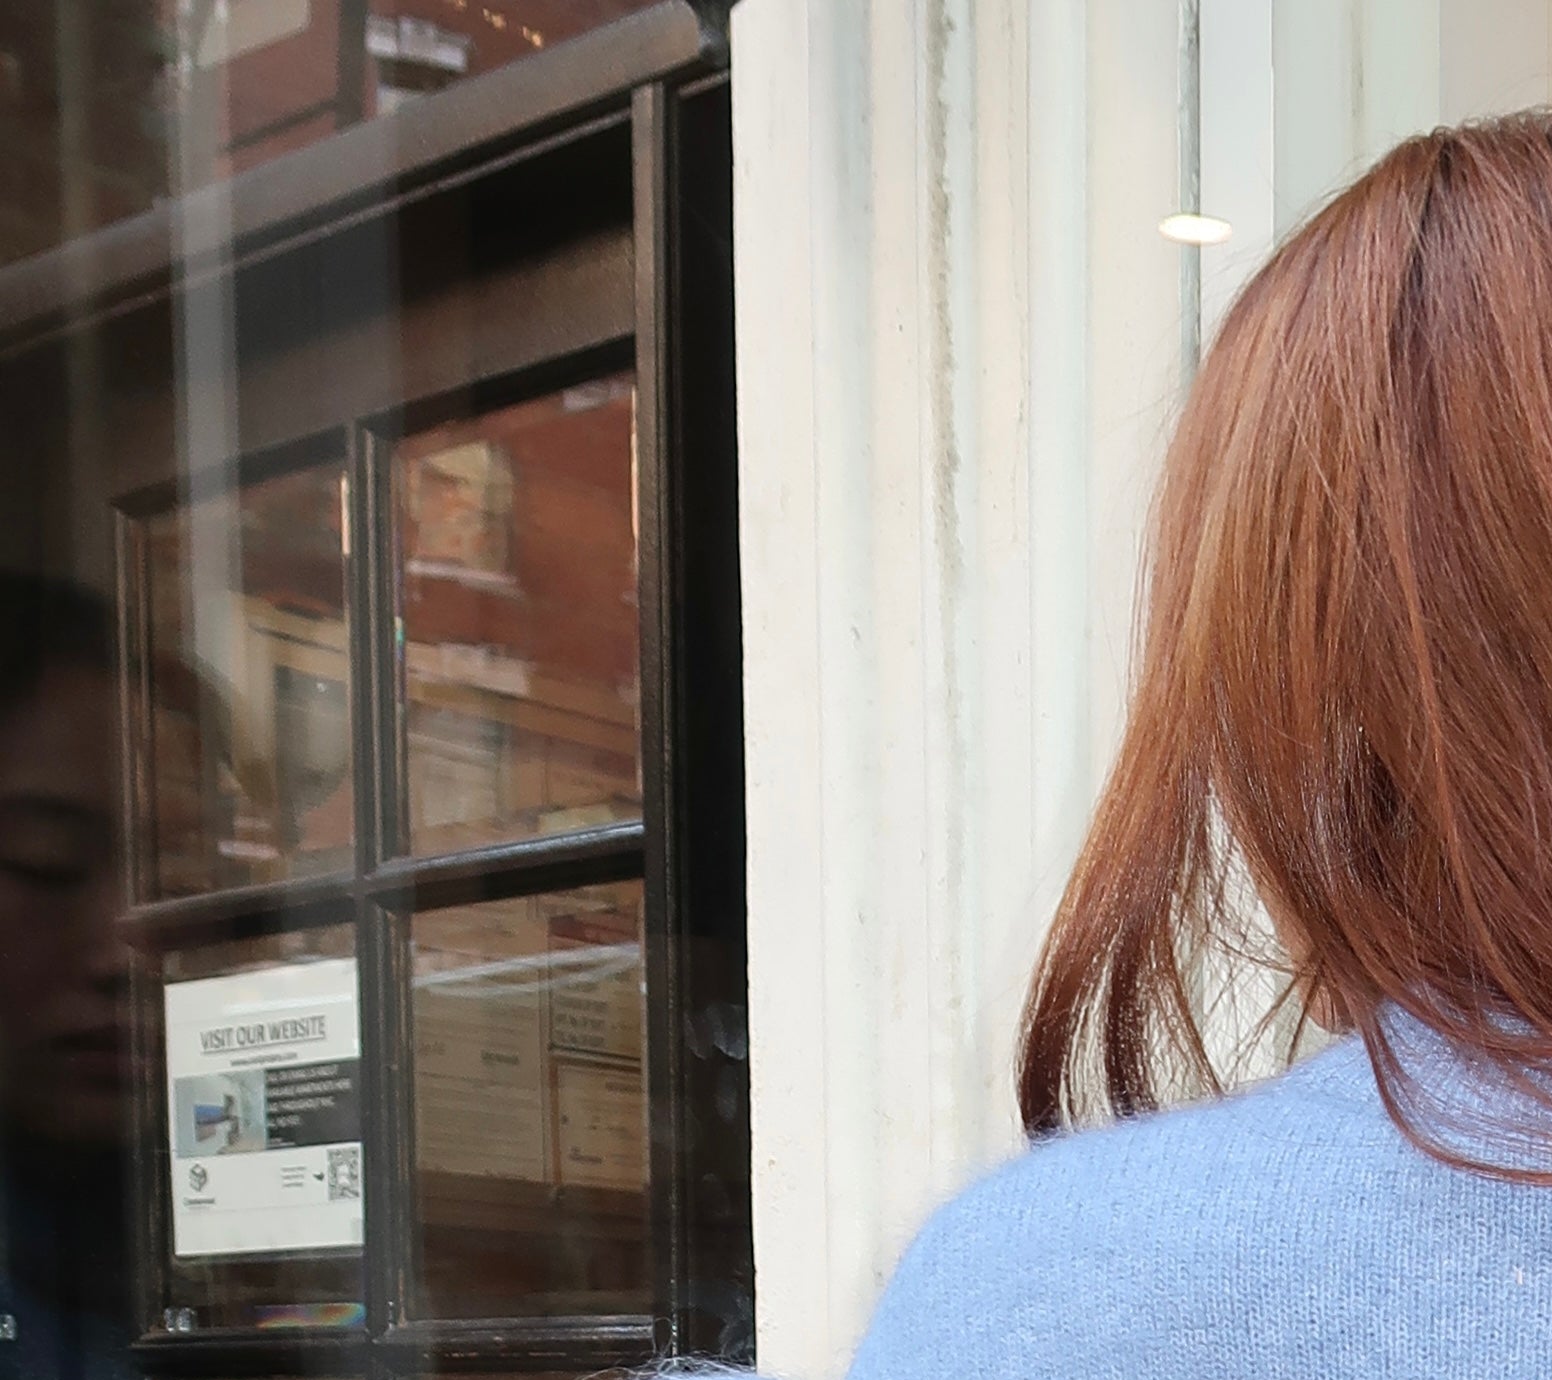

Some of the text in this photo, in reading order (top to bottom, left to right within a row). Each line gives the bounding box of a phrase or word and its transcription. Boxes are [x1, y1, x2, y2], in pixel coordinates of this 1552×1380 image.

[199, 1014, 327, 1050] VISIT OUR WEBSITE
